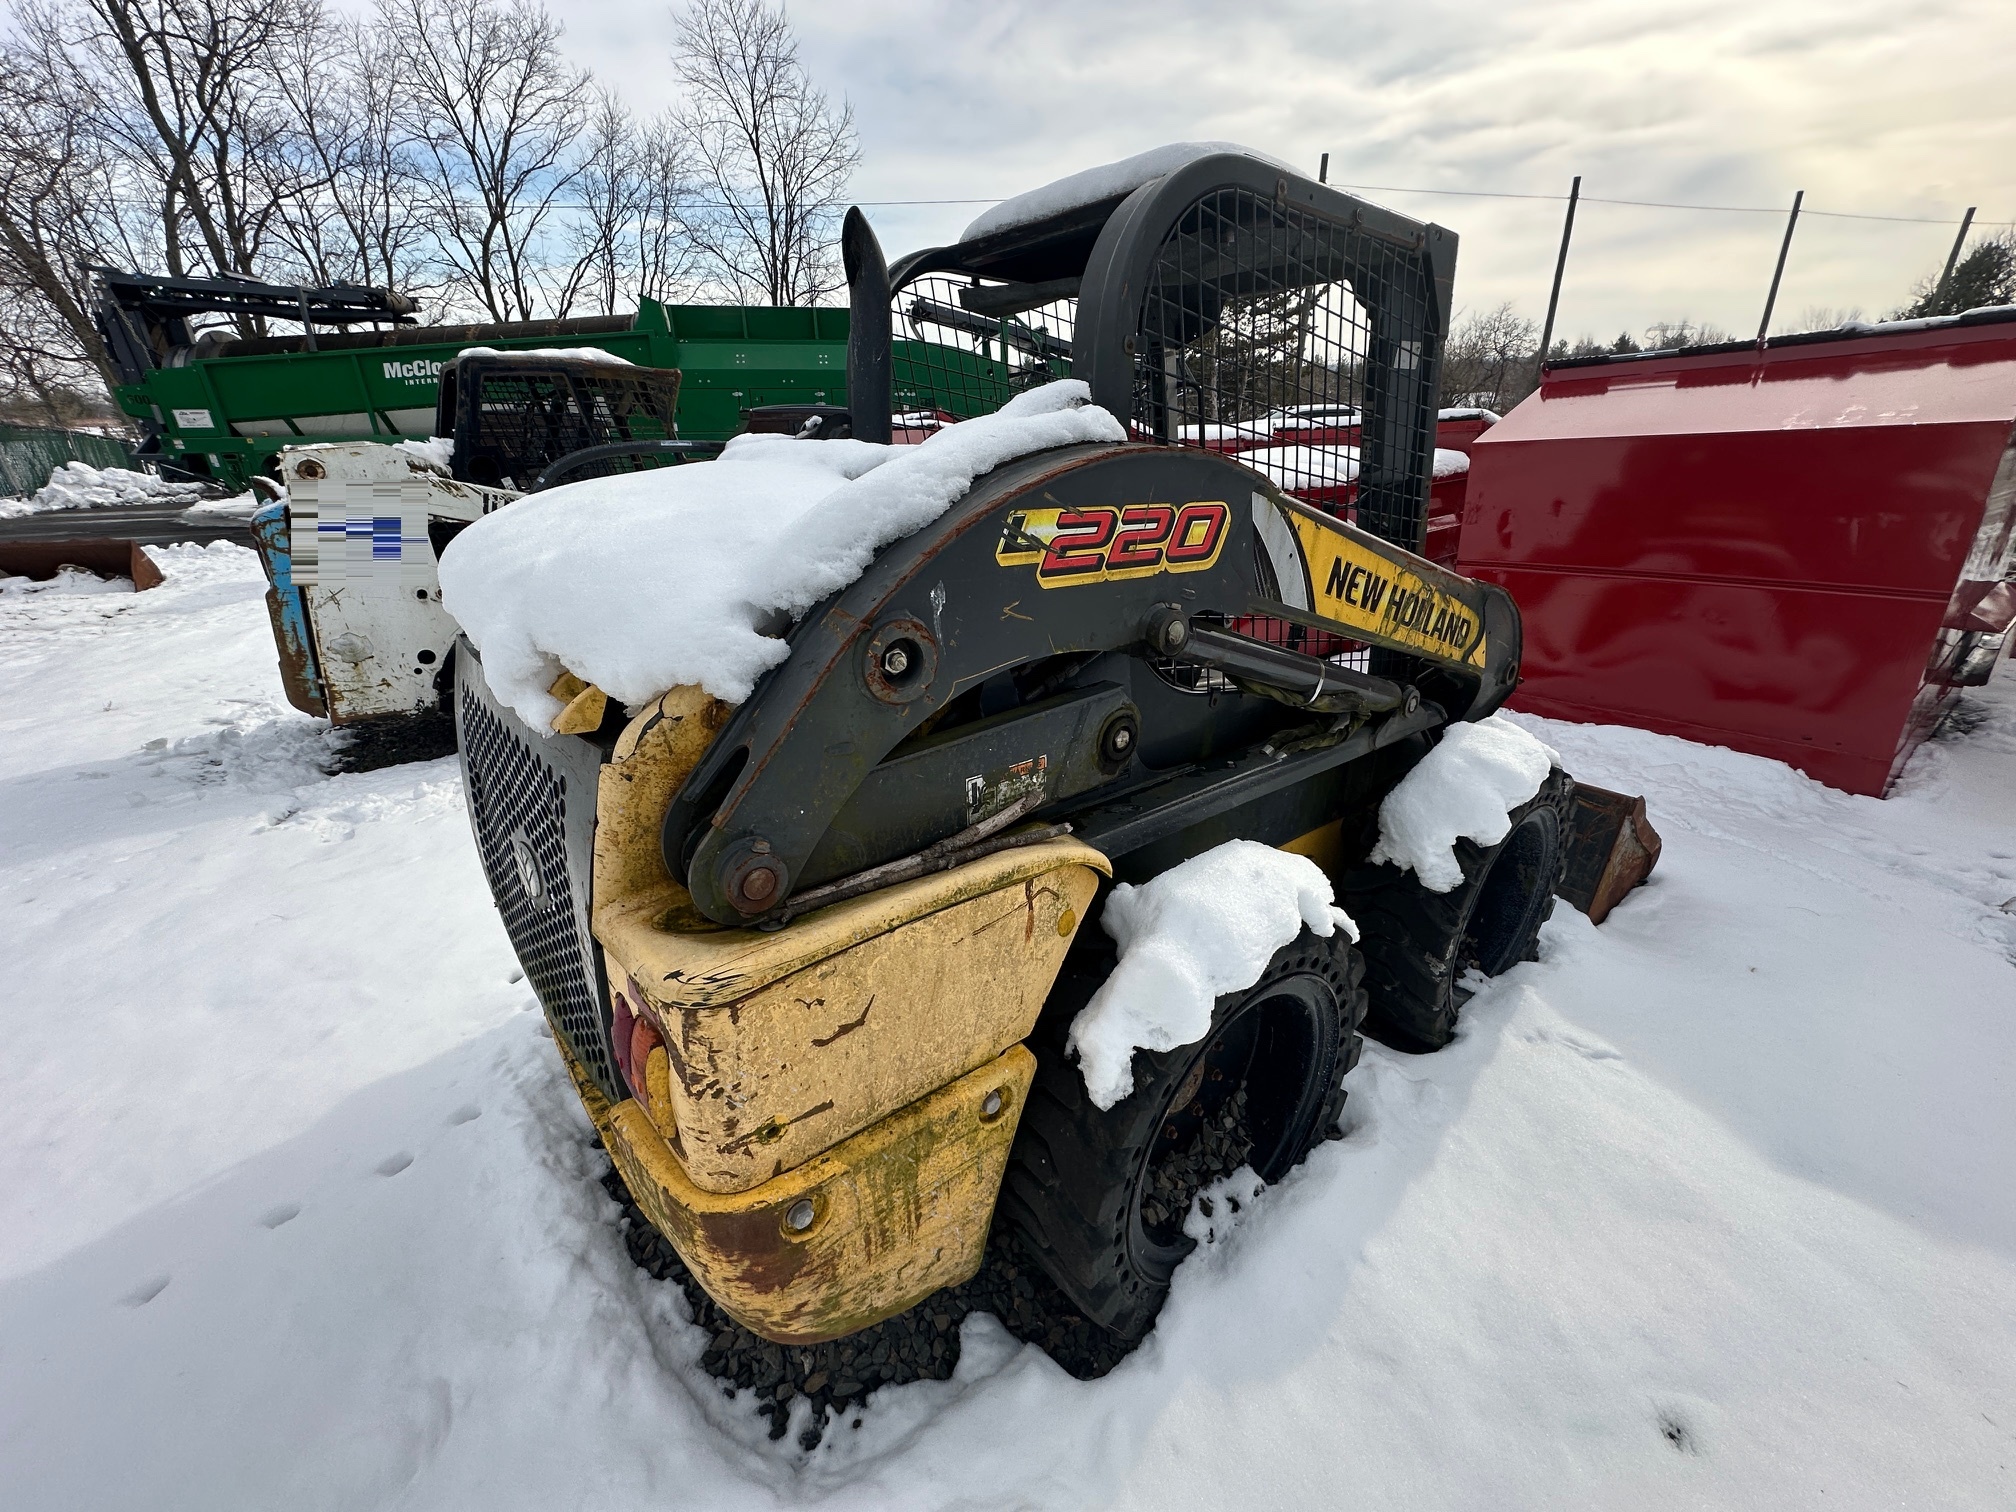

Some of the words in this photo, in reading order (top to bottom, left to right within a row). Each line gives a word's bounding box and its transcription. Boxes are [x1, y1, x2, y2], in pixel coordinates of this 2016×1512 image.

[382, 359, 446, 379] McClo
[996, 502, 1231, 588] L220
[1325, 555, 1388, 614] NEW
[1386, 583, 1471, 649] HOLLAND
